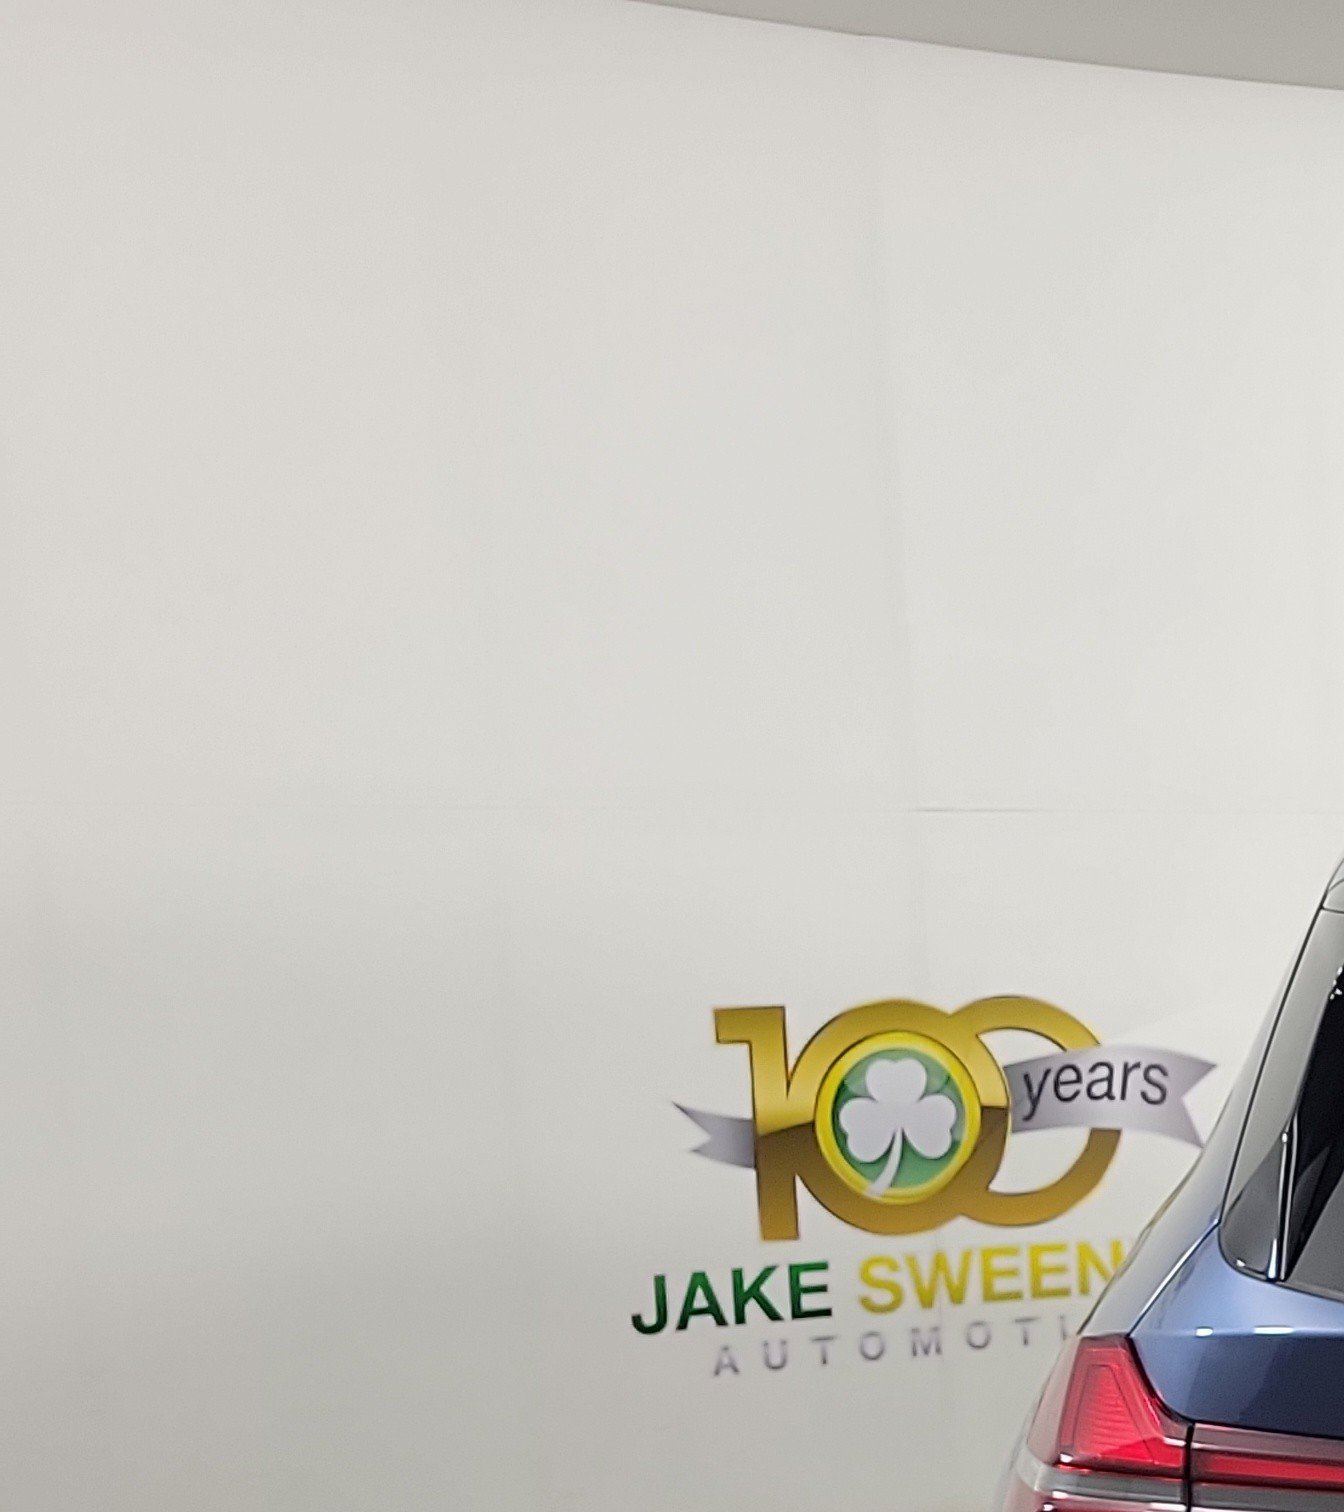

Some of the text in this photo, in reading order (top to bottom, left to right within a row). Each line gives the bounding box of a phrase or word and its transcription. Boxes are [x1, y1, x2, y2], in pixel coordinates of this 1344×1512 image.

[713, 995, 1169, 1241] 100 years
[631, 1238, 1124, 1335] JAKE SWEEN
[712, 1313, 1067, 1378] AUTOMOTI
